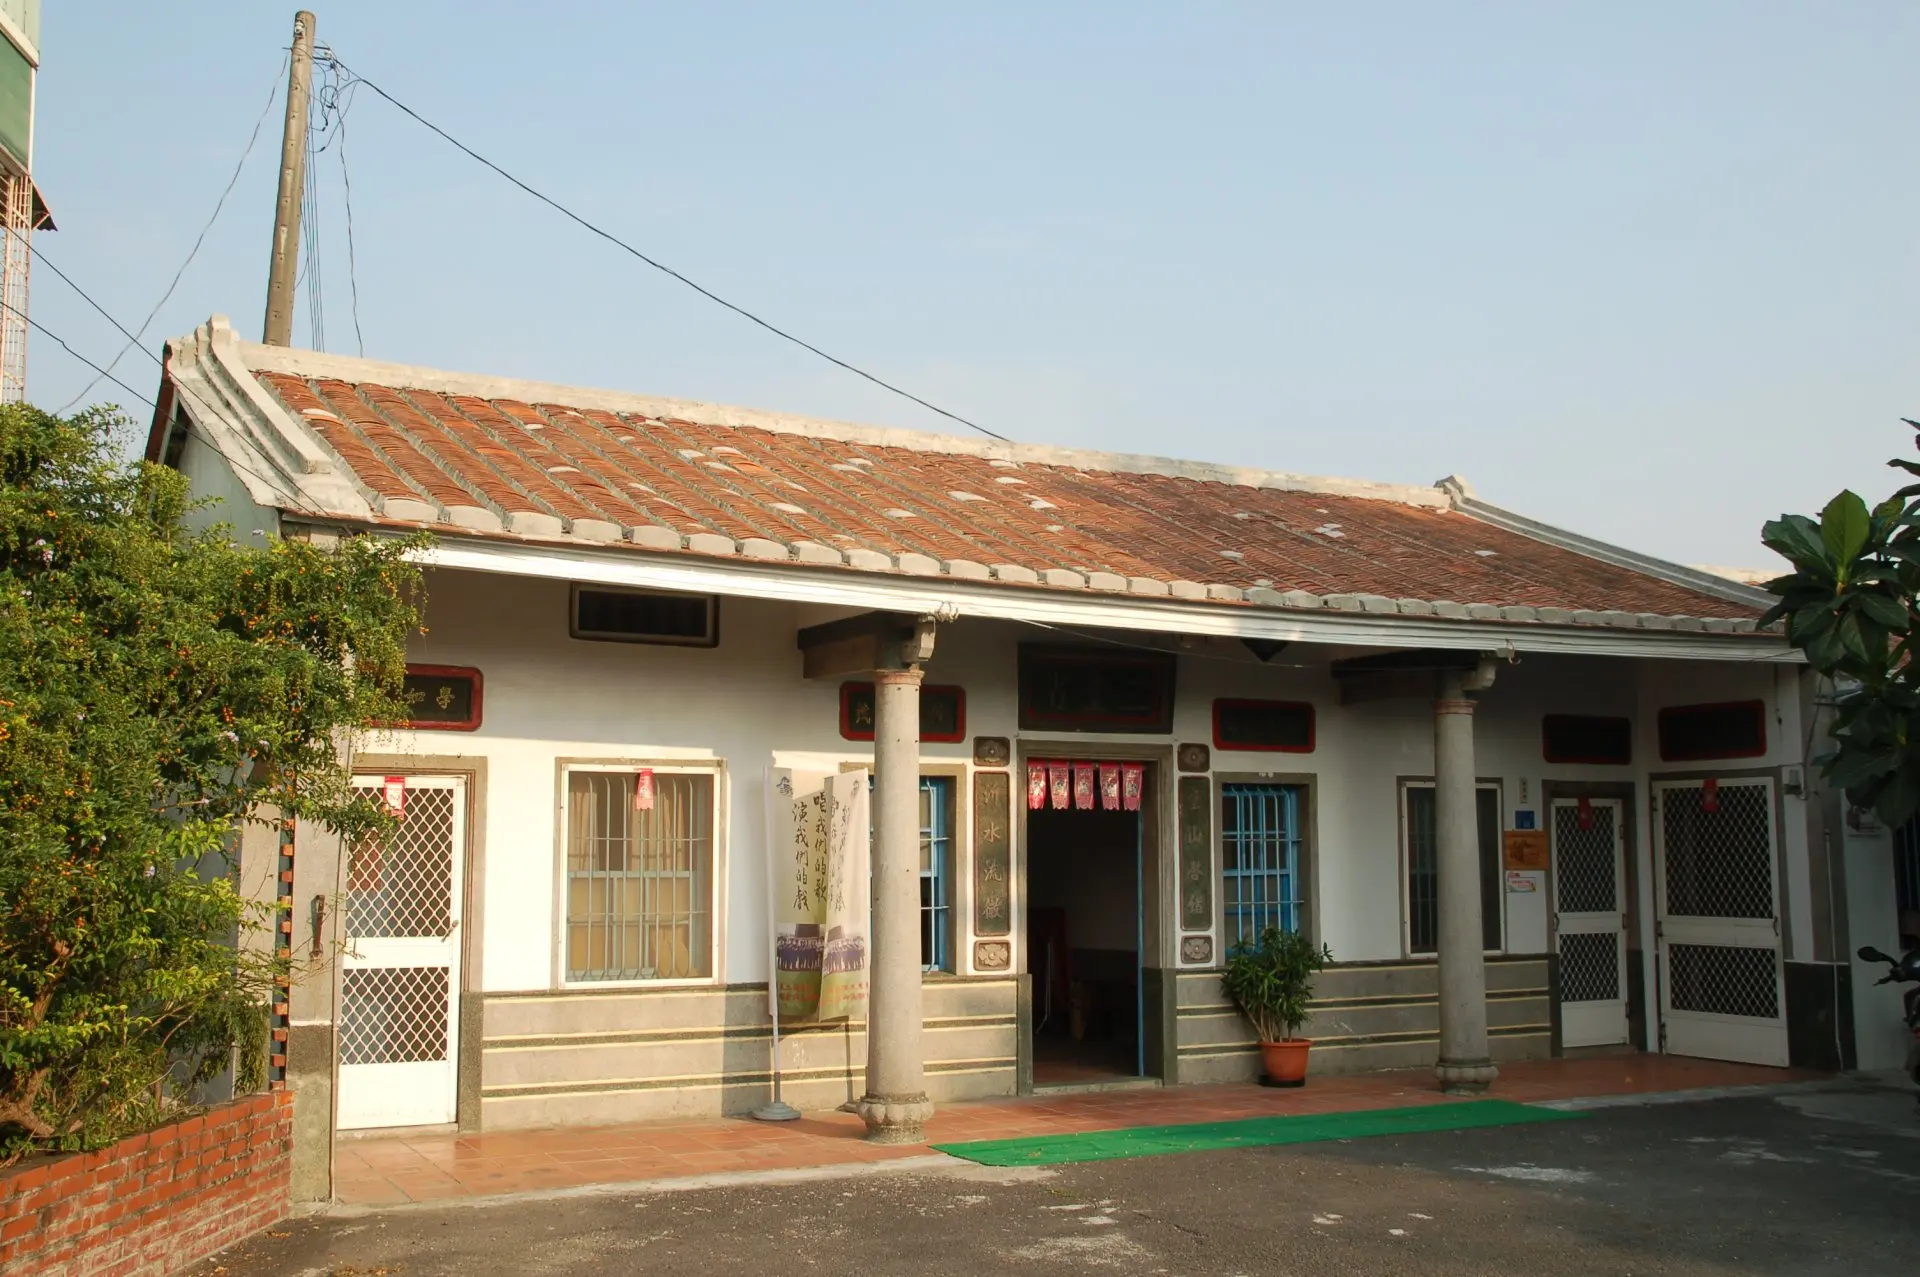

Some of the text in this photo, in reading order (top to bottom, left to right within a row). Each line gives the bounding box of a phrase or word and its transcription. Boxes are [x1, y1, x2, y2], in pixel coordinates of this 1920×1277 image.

[792, 801, 809, 911] 演我們的戲
[813, 791, 828, 903] 唱我們的歌
